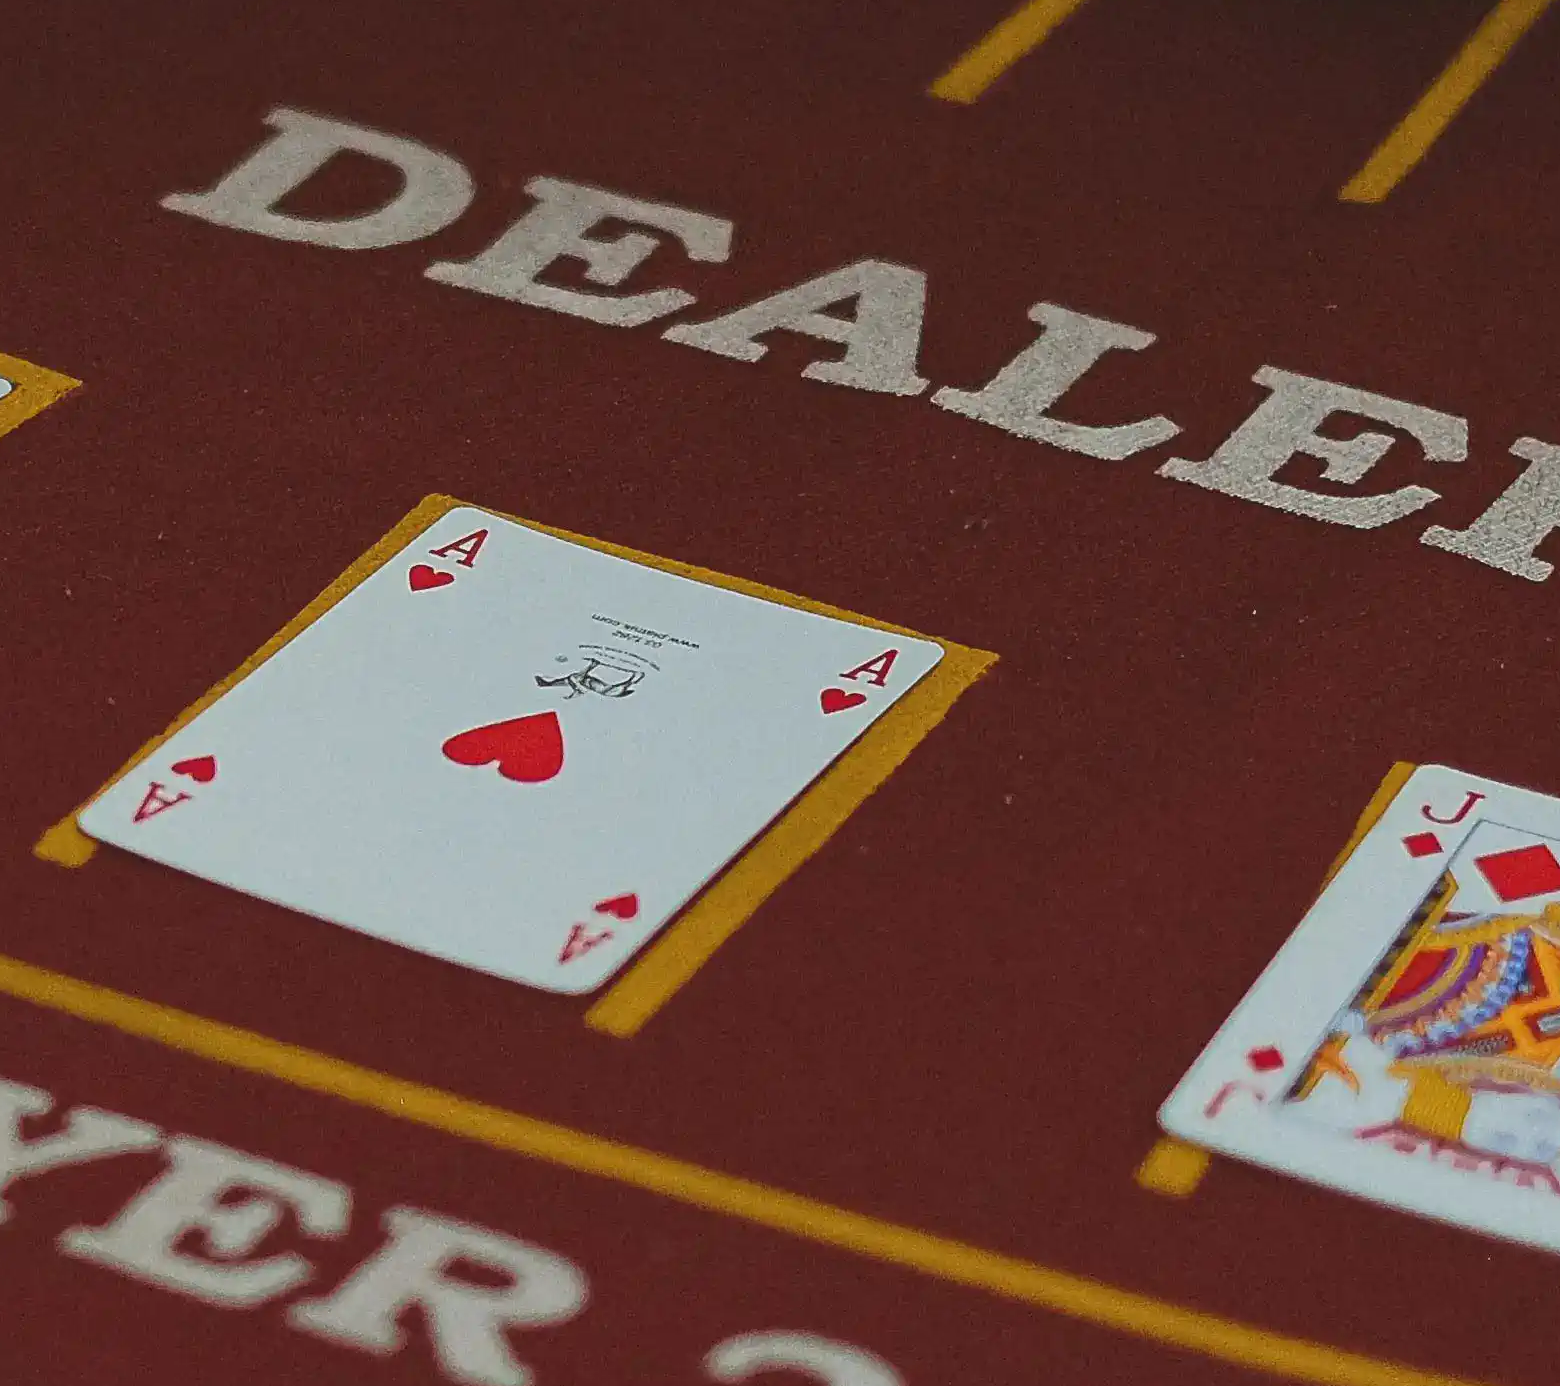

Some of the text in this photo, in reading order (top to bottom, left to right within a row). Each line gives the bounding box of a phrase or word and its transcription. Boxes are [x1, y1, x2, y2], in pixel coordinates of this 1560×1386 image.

[429, 529, 489, 568] A
[838, 648, 900, 688] A
[131, 780, 194, 825] A
[1420, 790, 1485, 825] J
[557, 922, 614, 966] A
